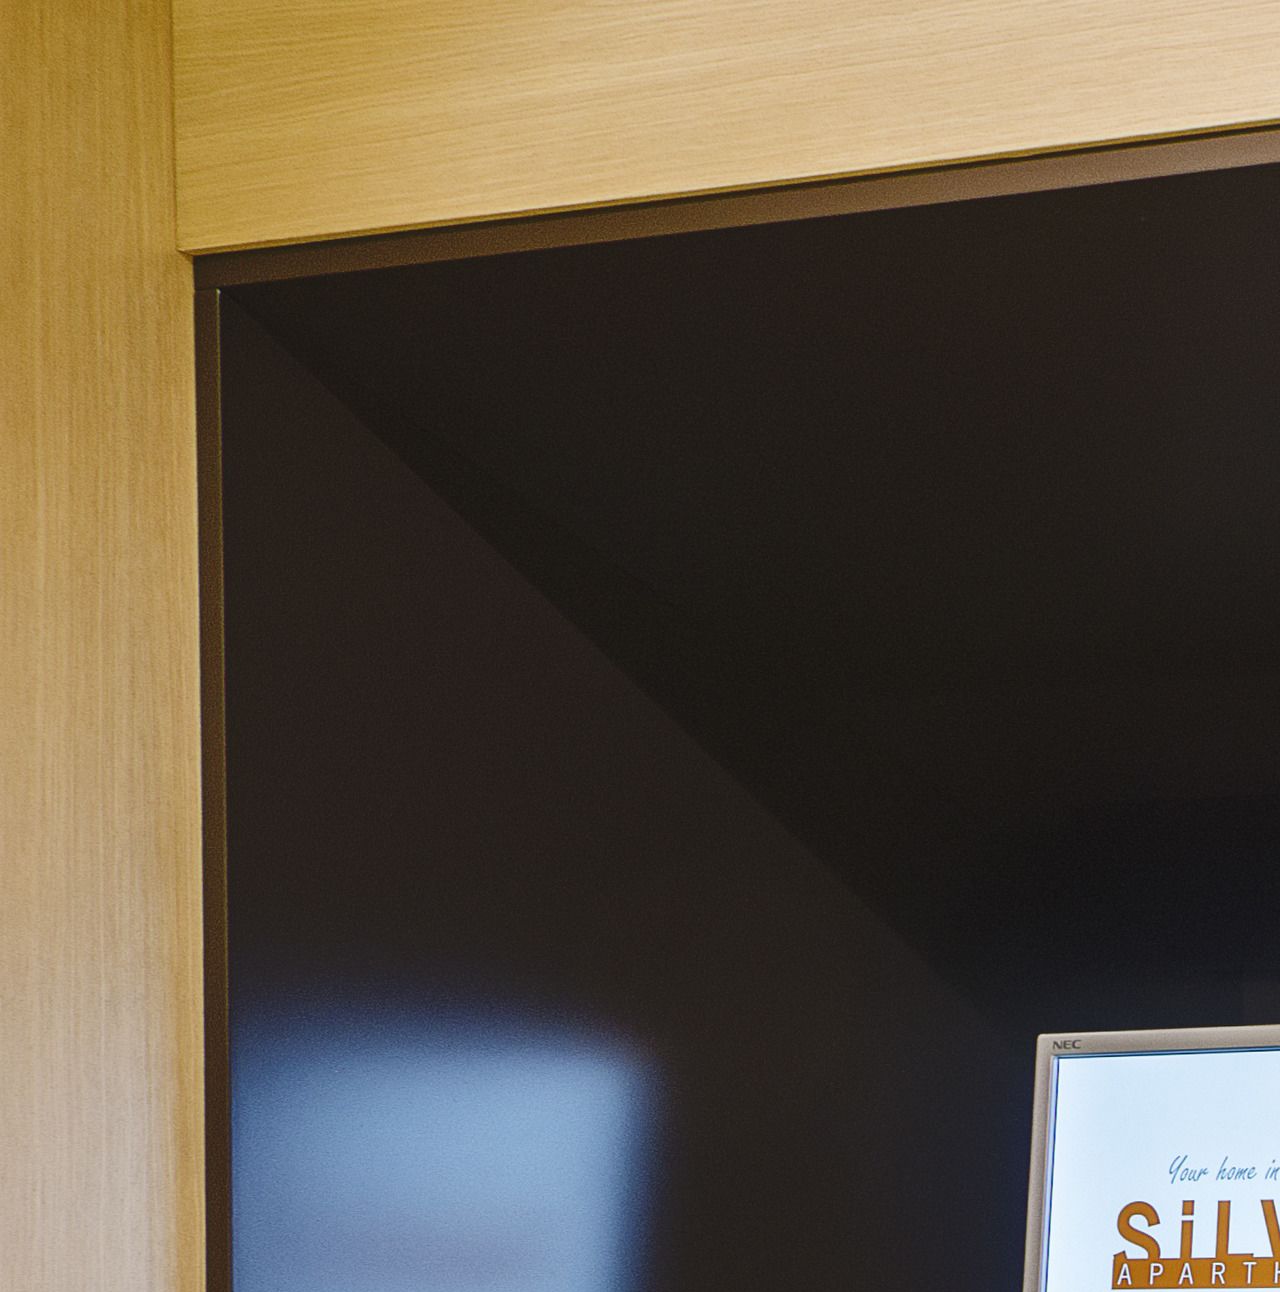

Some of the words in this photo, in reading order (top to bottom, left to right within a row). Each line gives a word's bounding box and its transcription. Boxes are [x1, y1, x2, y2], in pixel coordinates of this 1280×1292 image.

[1052, 1039, 1082, 1050] NEC
[1168, 1155, 1209, 1184] Your
[1215, 1156, 1257, 1181] home
[1264, 1159, 1280, 1180] in
